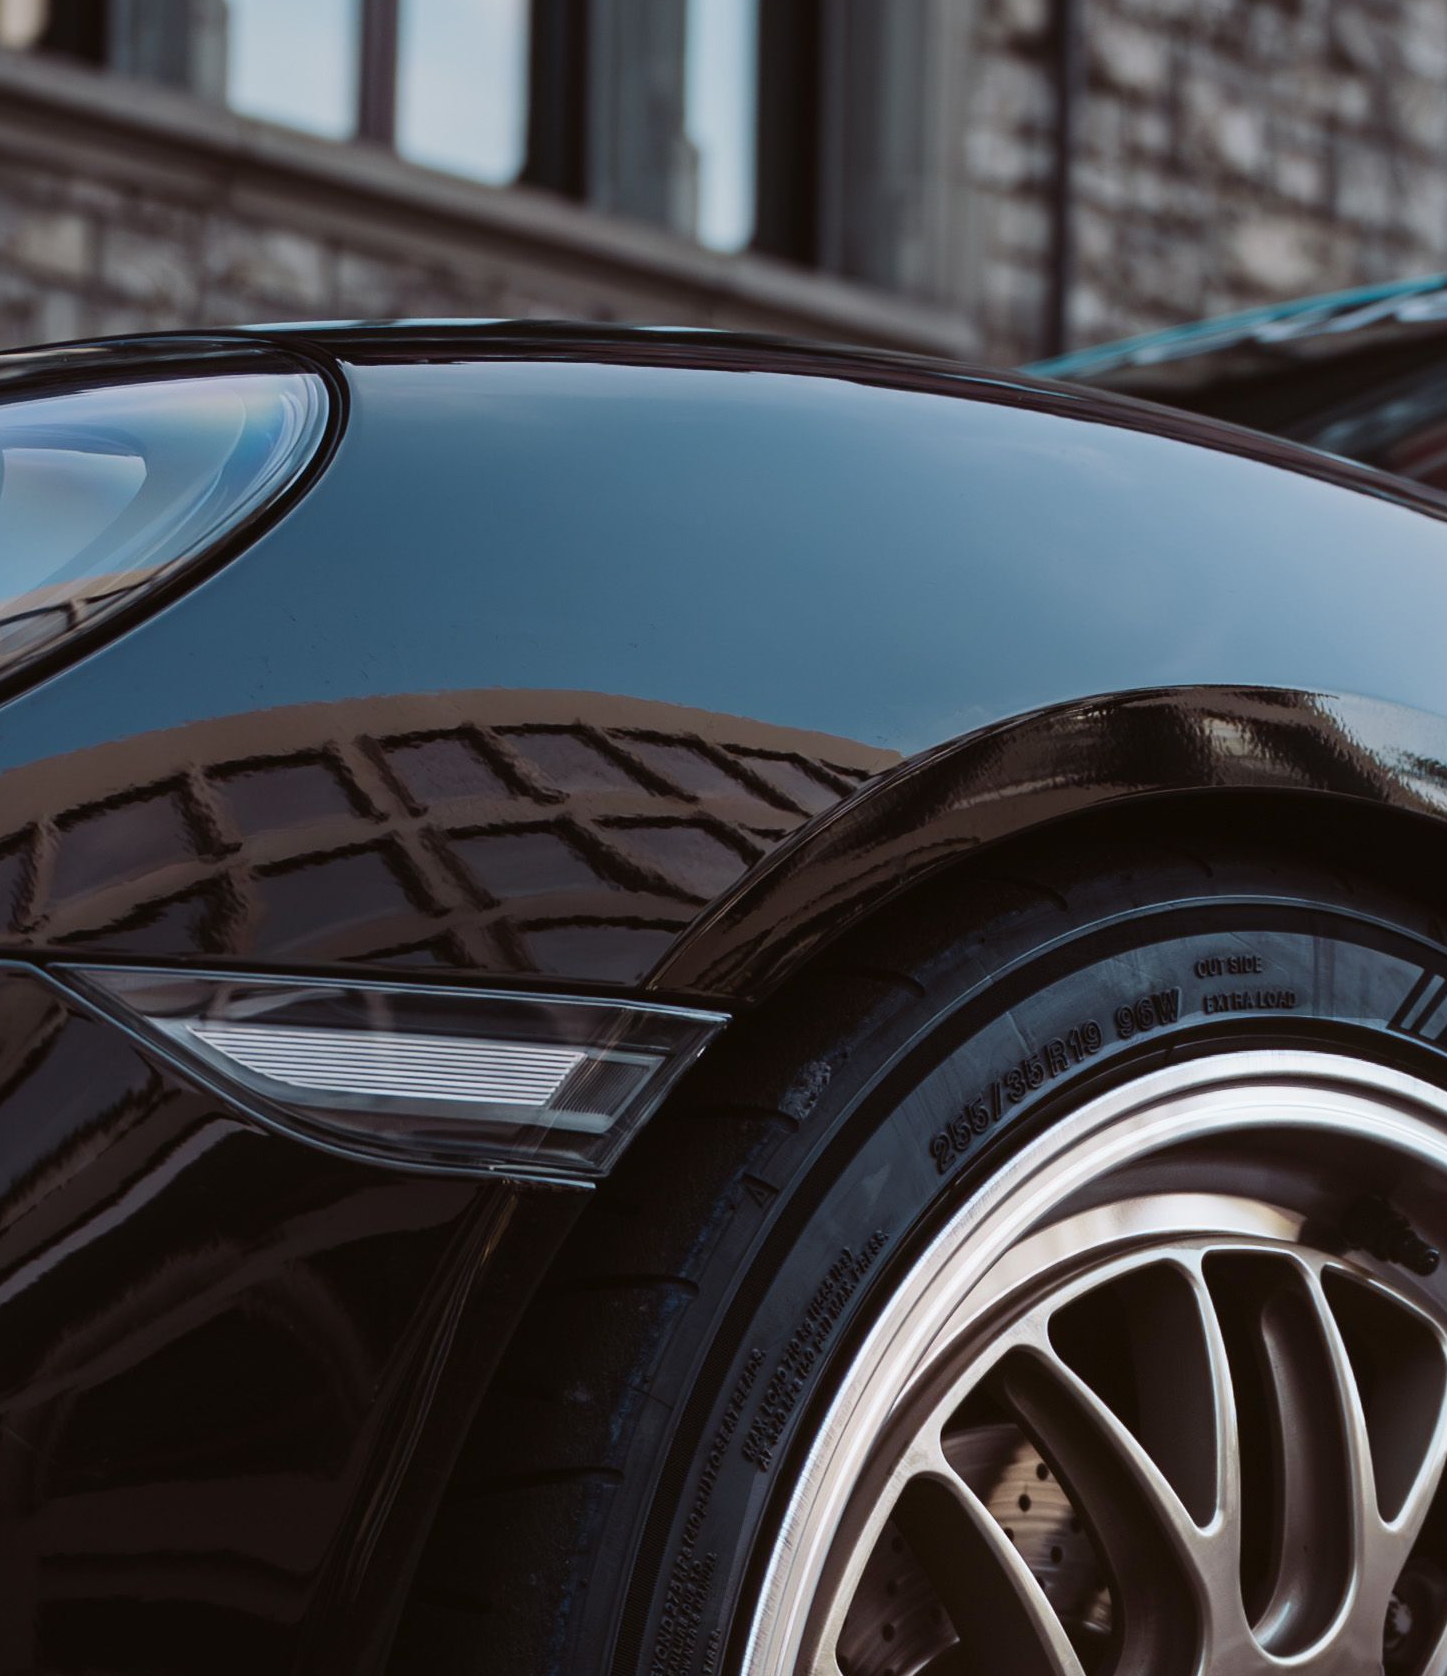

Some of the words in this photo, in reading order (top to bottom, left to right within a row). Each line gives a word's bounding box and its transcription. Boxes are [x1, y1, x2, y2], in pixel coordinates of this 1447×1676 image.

[1203, 992, 1255, 1013] EXTRA
[1256, 990, 1297, 1009] LOAD
[930, 1018, 1103, 1174] 255/35R19
[1115, 986, 1182, 1038] 96W
